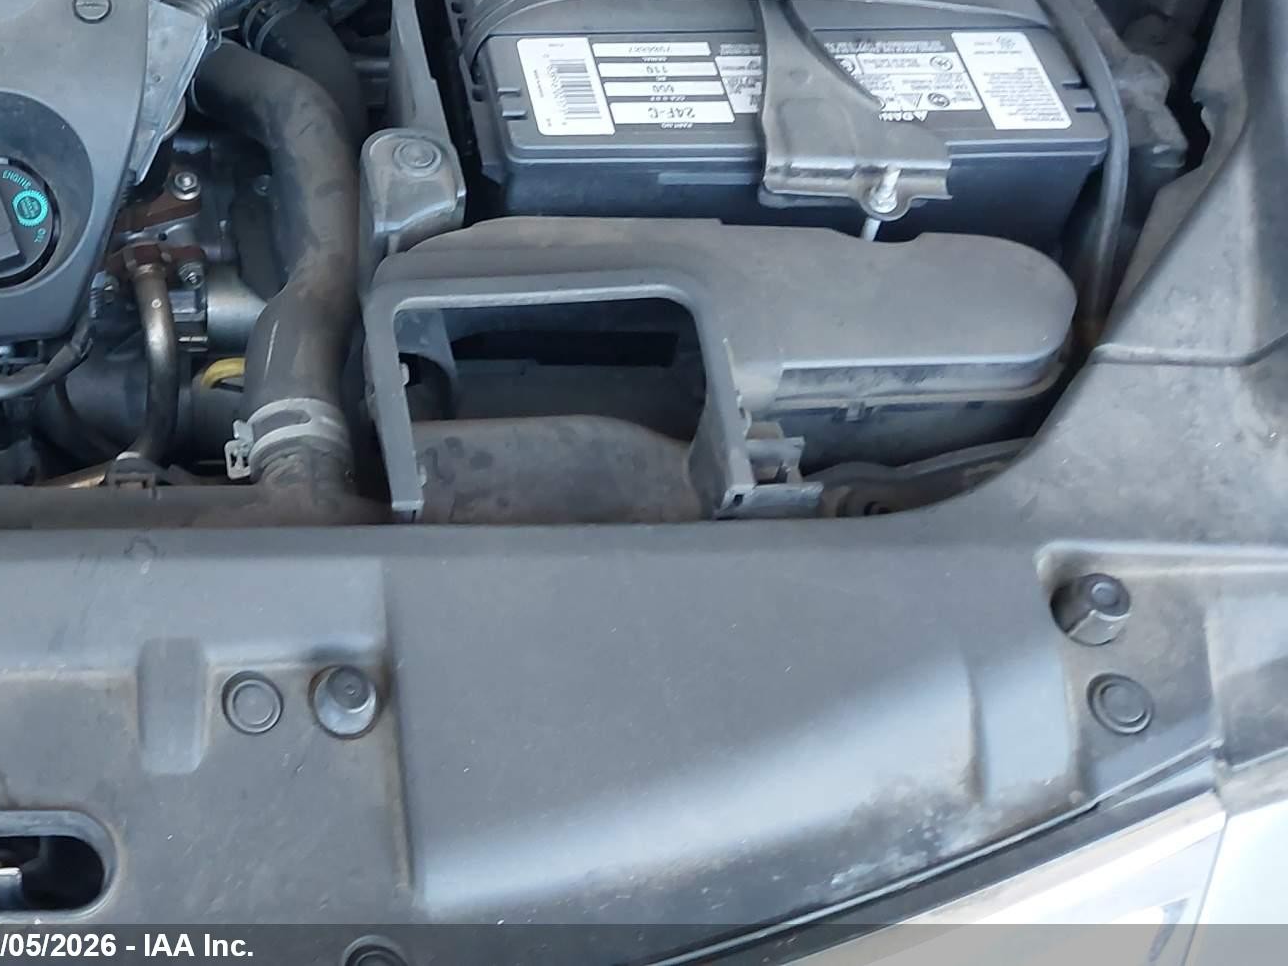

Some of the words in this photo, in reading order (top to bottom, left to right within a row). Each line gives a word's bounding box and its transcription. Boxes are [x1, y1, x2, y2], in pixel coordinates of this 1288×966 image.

[648, 107, 695, 119] 24F-C
[1, 169, 33, 190] ENGINE
[33, 227, 47, 244] OIL
